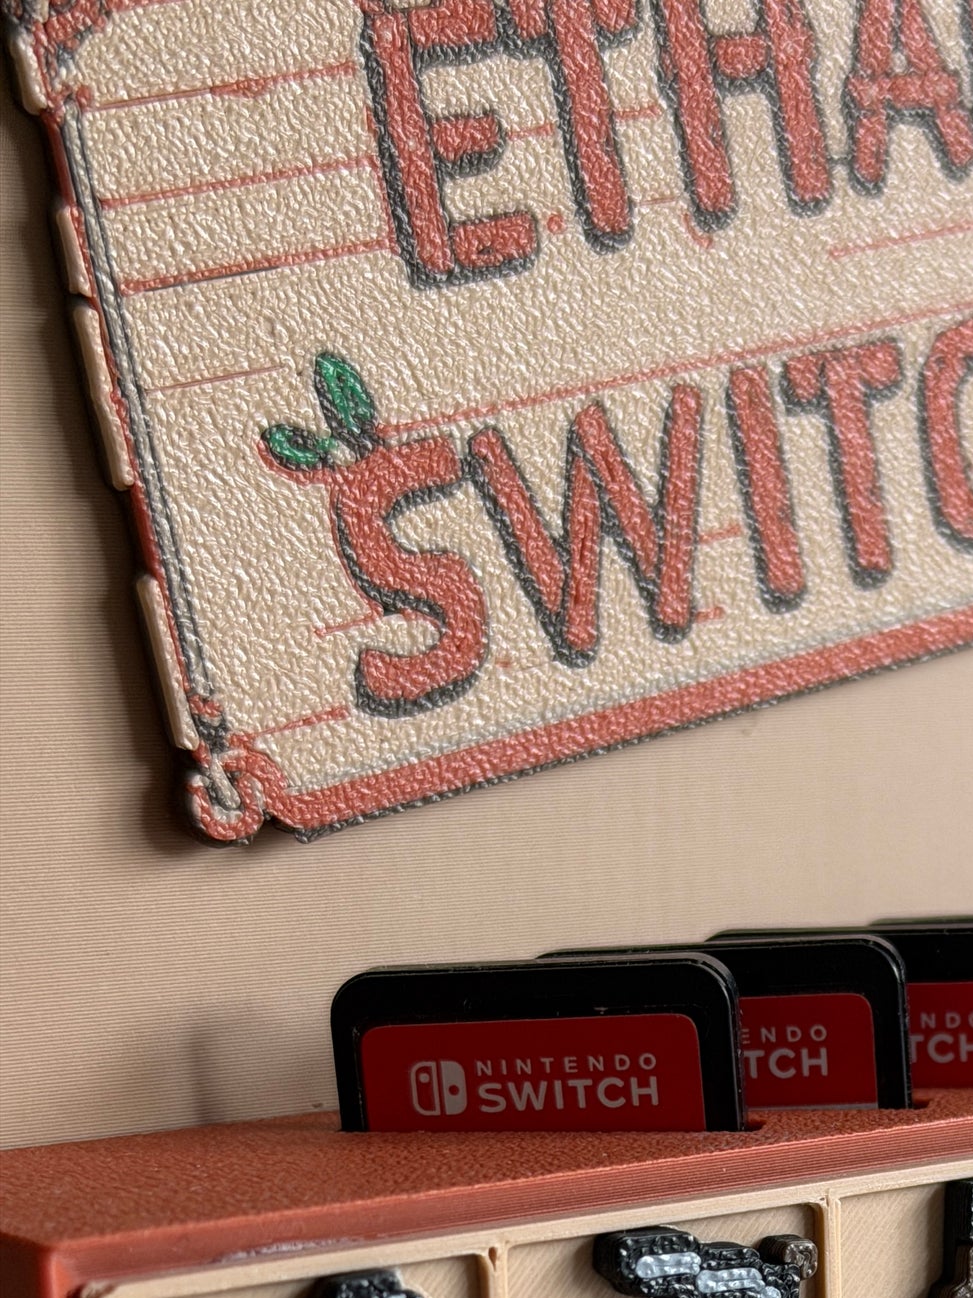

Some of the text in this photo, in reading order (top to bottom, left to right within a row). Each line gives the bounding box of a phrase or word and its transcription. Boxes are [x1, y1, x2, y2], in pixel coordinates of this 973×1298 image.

[475, 1052, 657, 1077] NINTENDO
[744, 1046, 829, 1080] TCH
[477, 1076, 660, 1114] SWITCH
